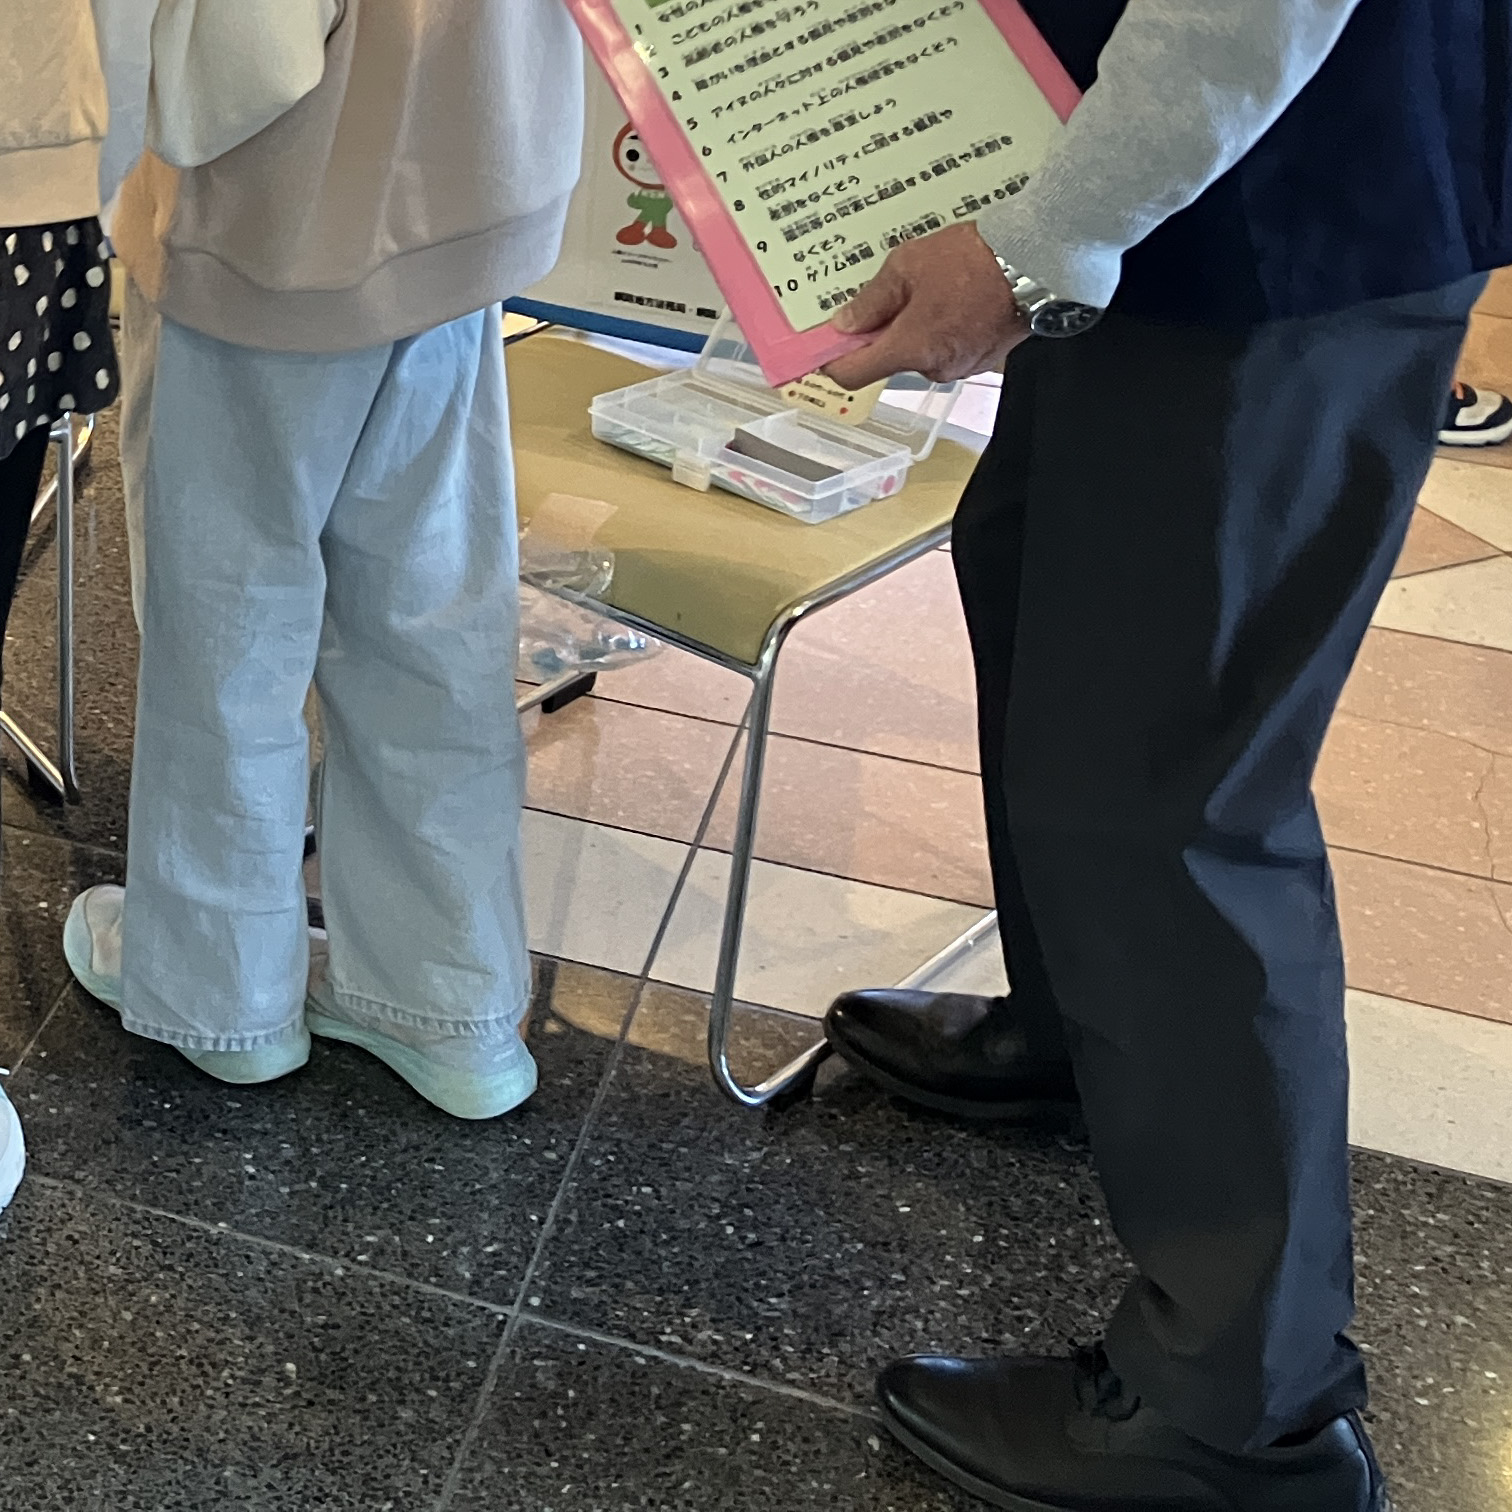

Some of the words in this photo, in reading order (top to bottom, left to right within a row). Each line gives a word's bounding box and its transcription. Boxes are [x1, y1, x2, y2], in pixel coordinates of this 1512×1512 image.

[658, 66, 669, 79] 3
[686, 117, 699, 131] 5
[701, 144, 713, 157] 6
[716, 170, 728, 184] 7
[733, 199, 746, 212] 8
[756, 240, 768, 253] 9
[792, 233, 847, 263] なくそう
[773, 278, 799, 298] 10
[818, 280, 872, 311] 差別を
